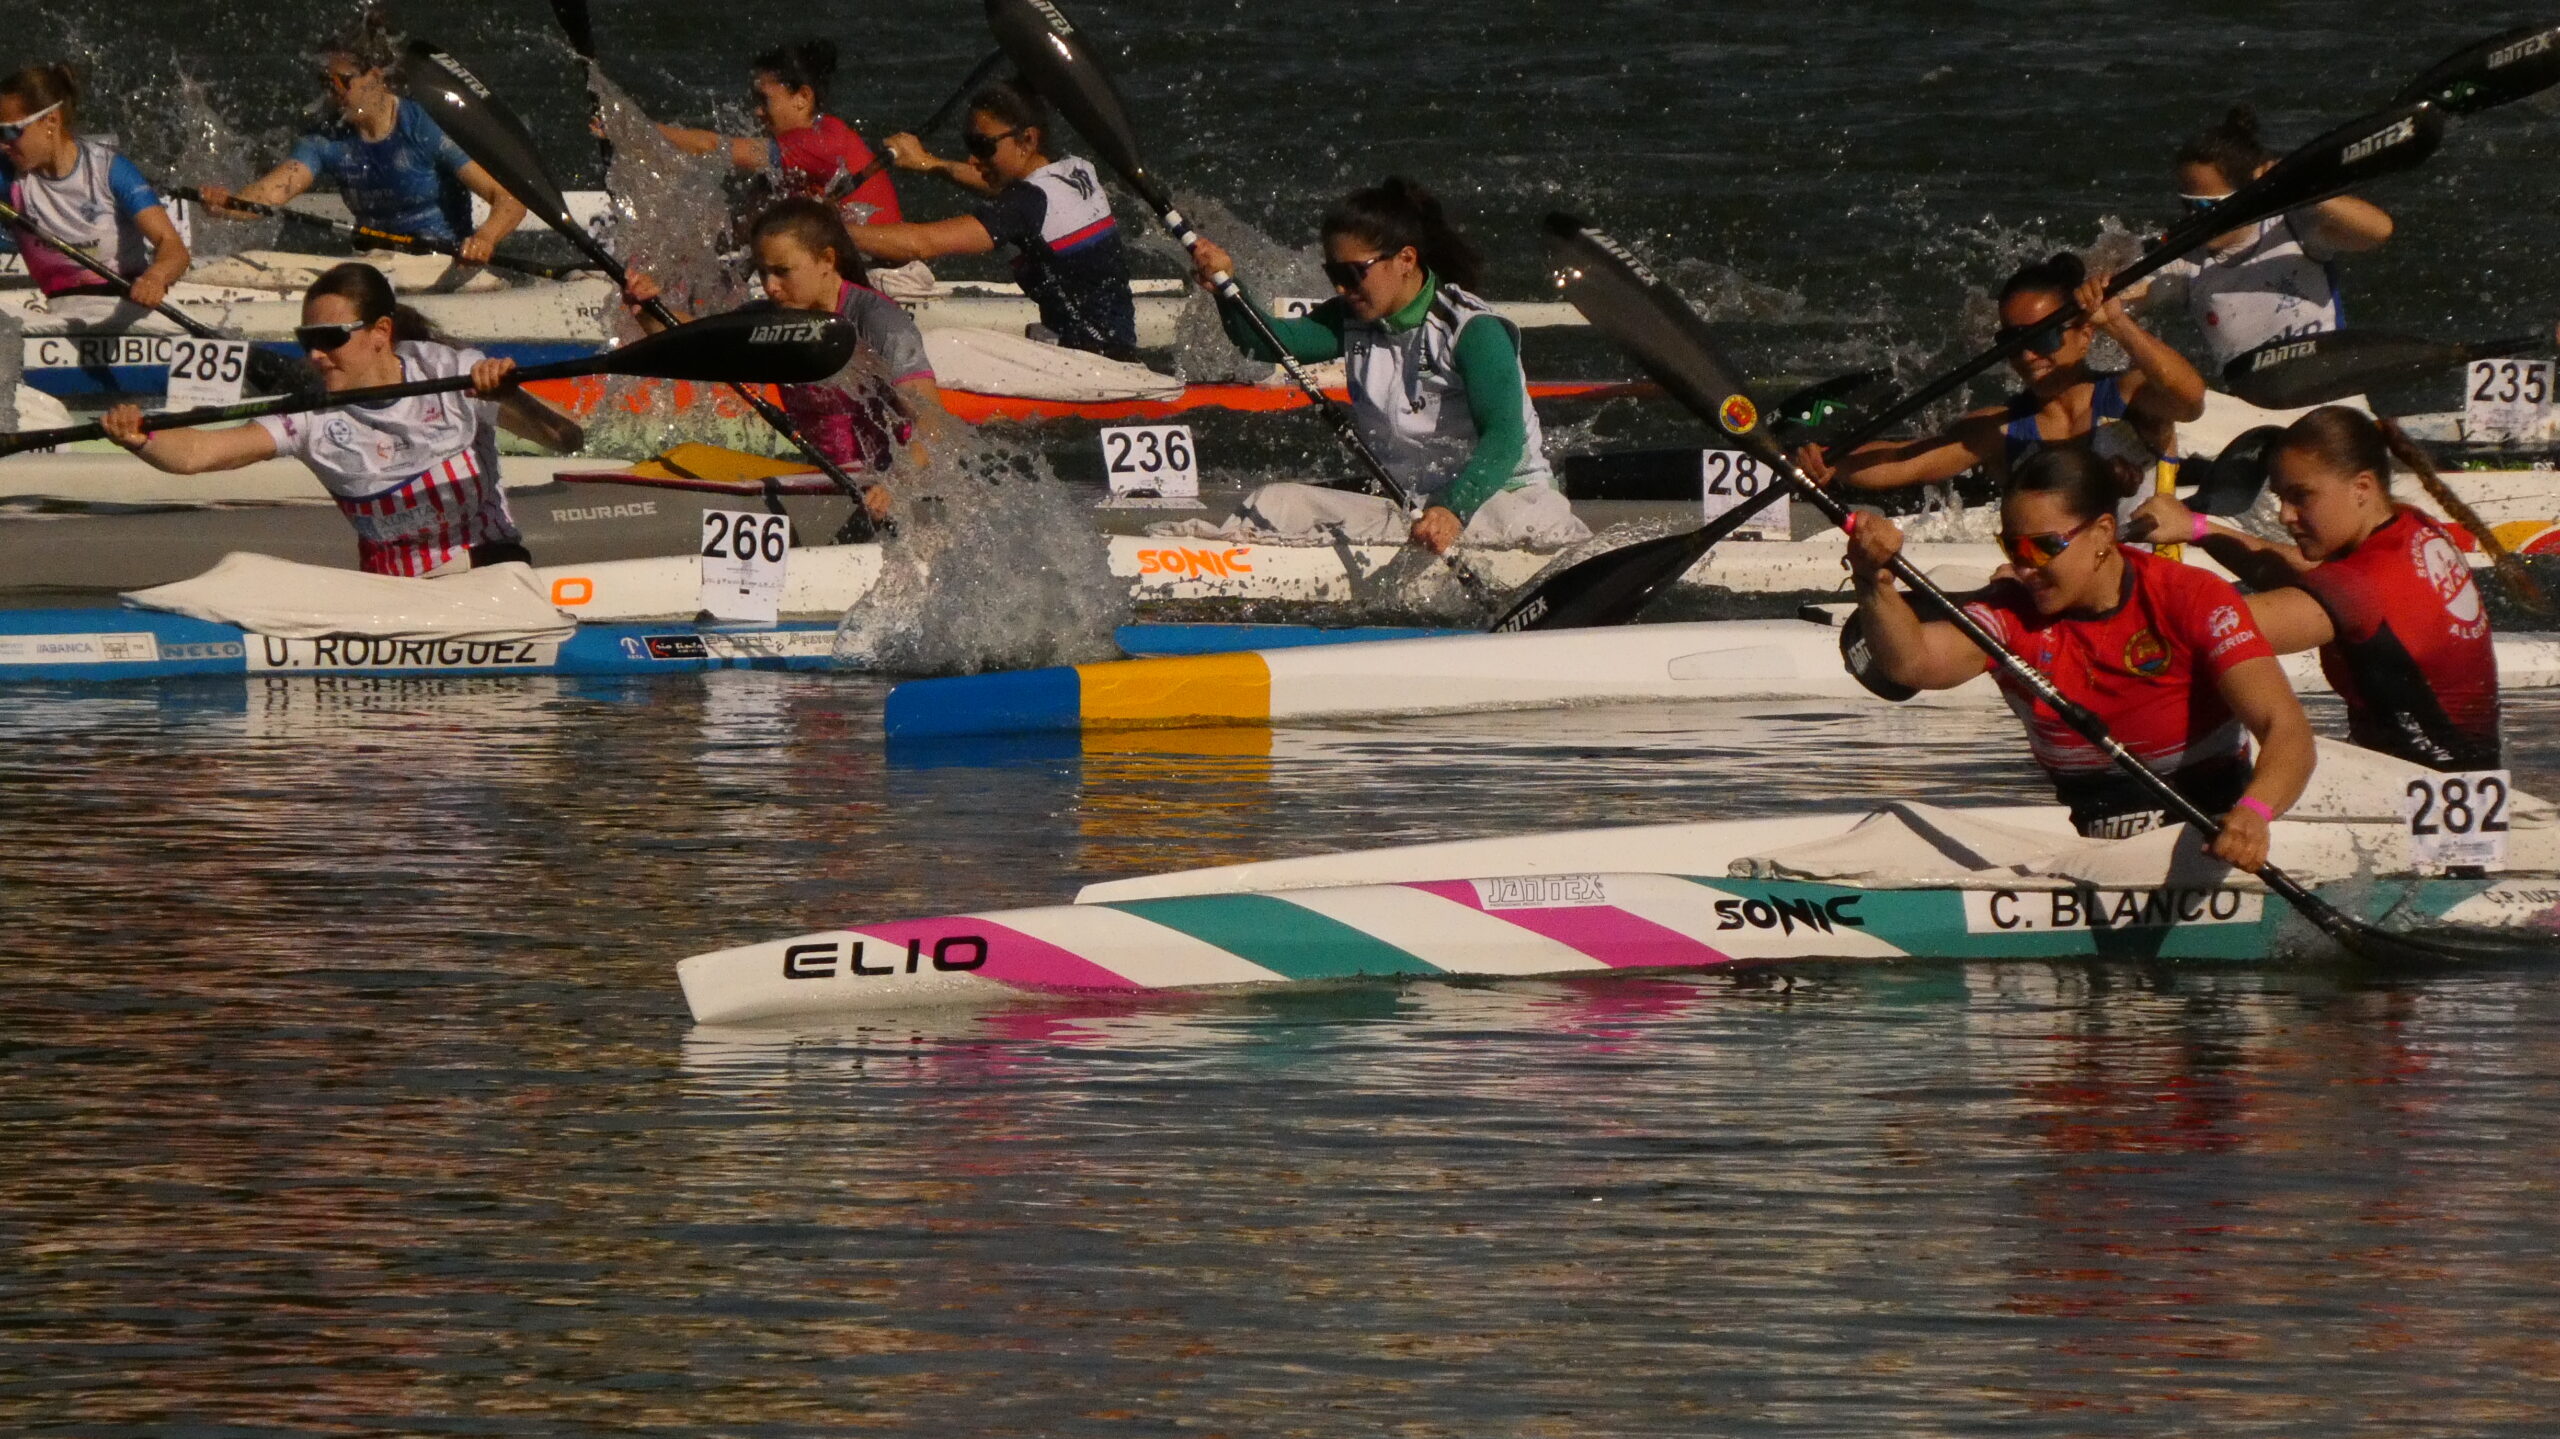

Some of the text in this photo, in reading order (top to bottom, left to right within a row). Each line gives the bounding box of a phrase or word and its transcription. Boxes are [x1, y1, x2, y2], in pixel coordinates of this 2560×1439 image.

[748, 320, 826, 343] JANTEX
[39, 341, 69, 366] C.
[171, 341, 244, 383] 285
[2252, 340, 2318, 373] JANTEX
[2473, 362, 2547, 404] 235
[1107, 430, 1191, 473] 236
[551, 501, 658, 522] ROURACE
[702, 512, 785, 563] 266
[1137, 546, 1253, 579] SONIC
[263, 634, 537, 667] U. RODRIGUEZ
[2406, 776, 2508, 835] 282
[1714, 894, 1865, 937] SONIC
[1990, 887, 2242, 929] C. BLANCO
[783, 935, 988, 980] ELIO
